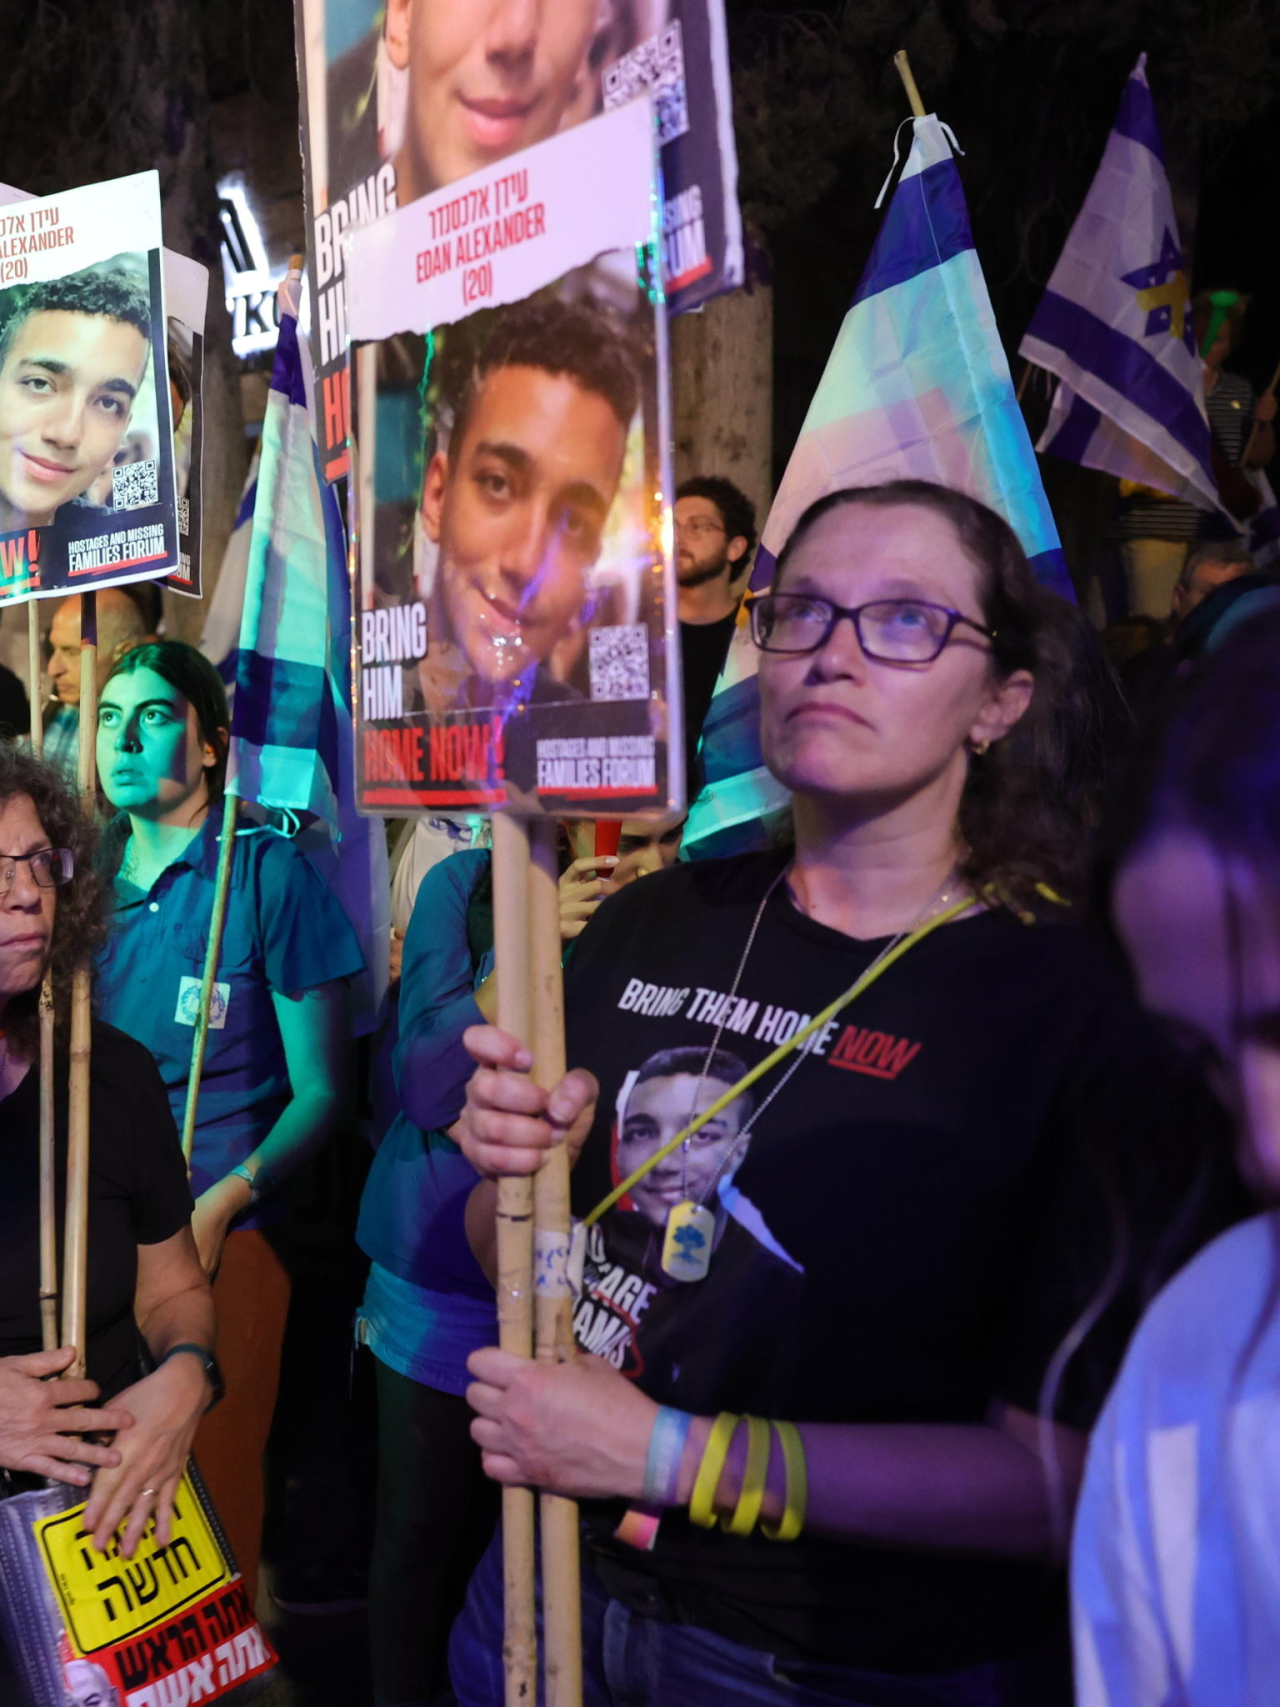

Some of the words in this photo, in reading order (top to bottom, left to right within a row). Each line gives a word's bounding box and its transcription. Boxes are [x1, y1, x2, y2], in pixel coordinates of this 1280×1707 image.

[30, 207, 59, 231] עידן
[428, 185, 489, 239] אלכסנדר
[494, 168, 528, 215] עידן
[0, 258, 28, 283] (20)
[416, 241, 451, 283] EDAN
[456, 203, 545, 267] ALEXANDER
[463, 261, 493, 306] (20)
[318, 280, 346, 364] HI
[68, 537, 109, 554] HOSTAGES
[110, 531, 126, 546] AND
[127, 523, 164, 541] MISSING
[68, 545, 120, 572] FAMILIES
[123, 536, 165, 561] FORUM
[361, 603, 427, 664] BRING
[363, 664, 403, 721] HIM
[364, 728, 425, 781] HOME
[617, 977, 690, 1017] BRING
[685, 987, 760, 1035] THEM
[830, 1025, 923, 1074] NOW
[572, 1294, 634, 1369] AMAS
[97, 1536, 201, 1622] חדשה
[115, 1613, 207, 1690] הראש
[214, 1624, 272, 1686] אתה
